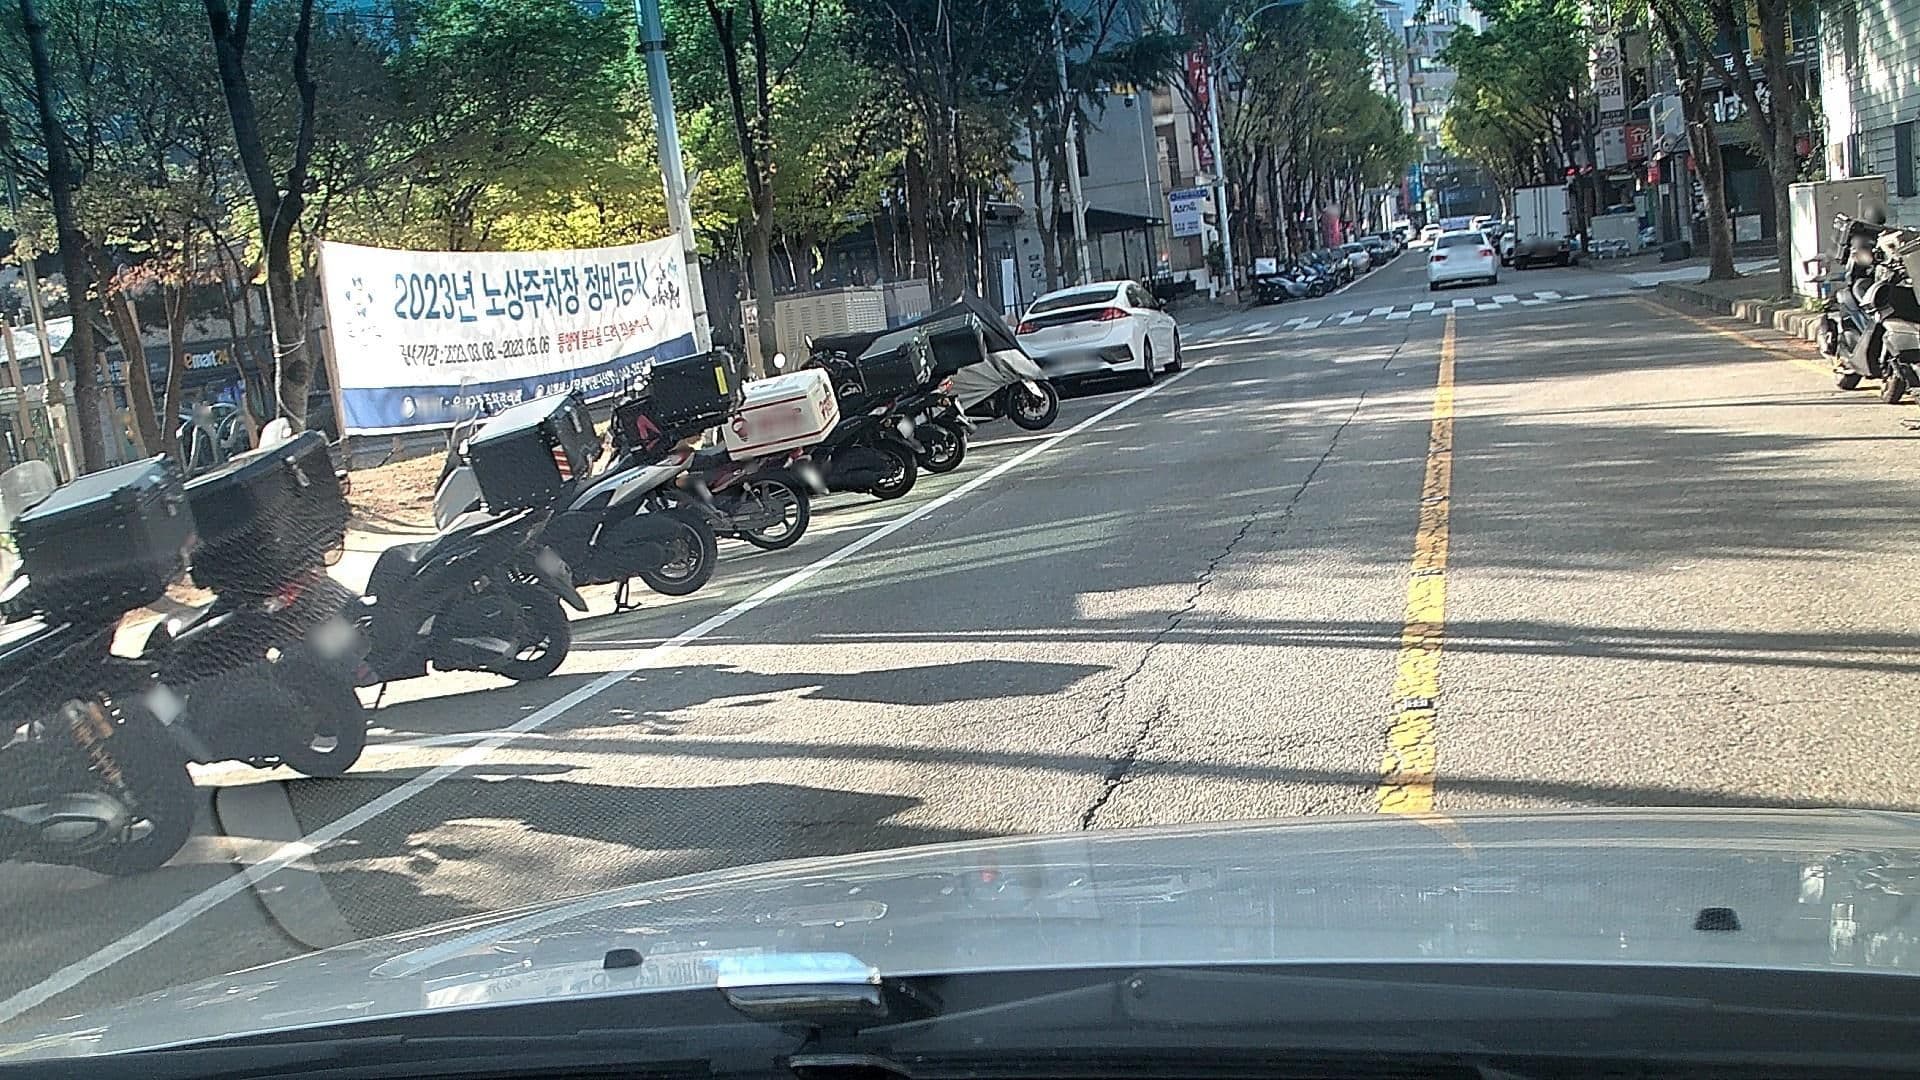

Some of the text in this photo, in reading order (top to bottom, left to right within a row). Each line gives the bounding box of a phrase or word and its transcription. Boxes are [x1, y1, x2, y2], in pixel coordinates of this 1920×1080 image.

[394, 270, 478, 323] 2023년
[481, 265, 581, 321] 노상주차장
[583, 257, 651, 312] 정비공사
